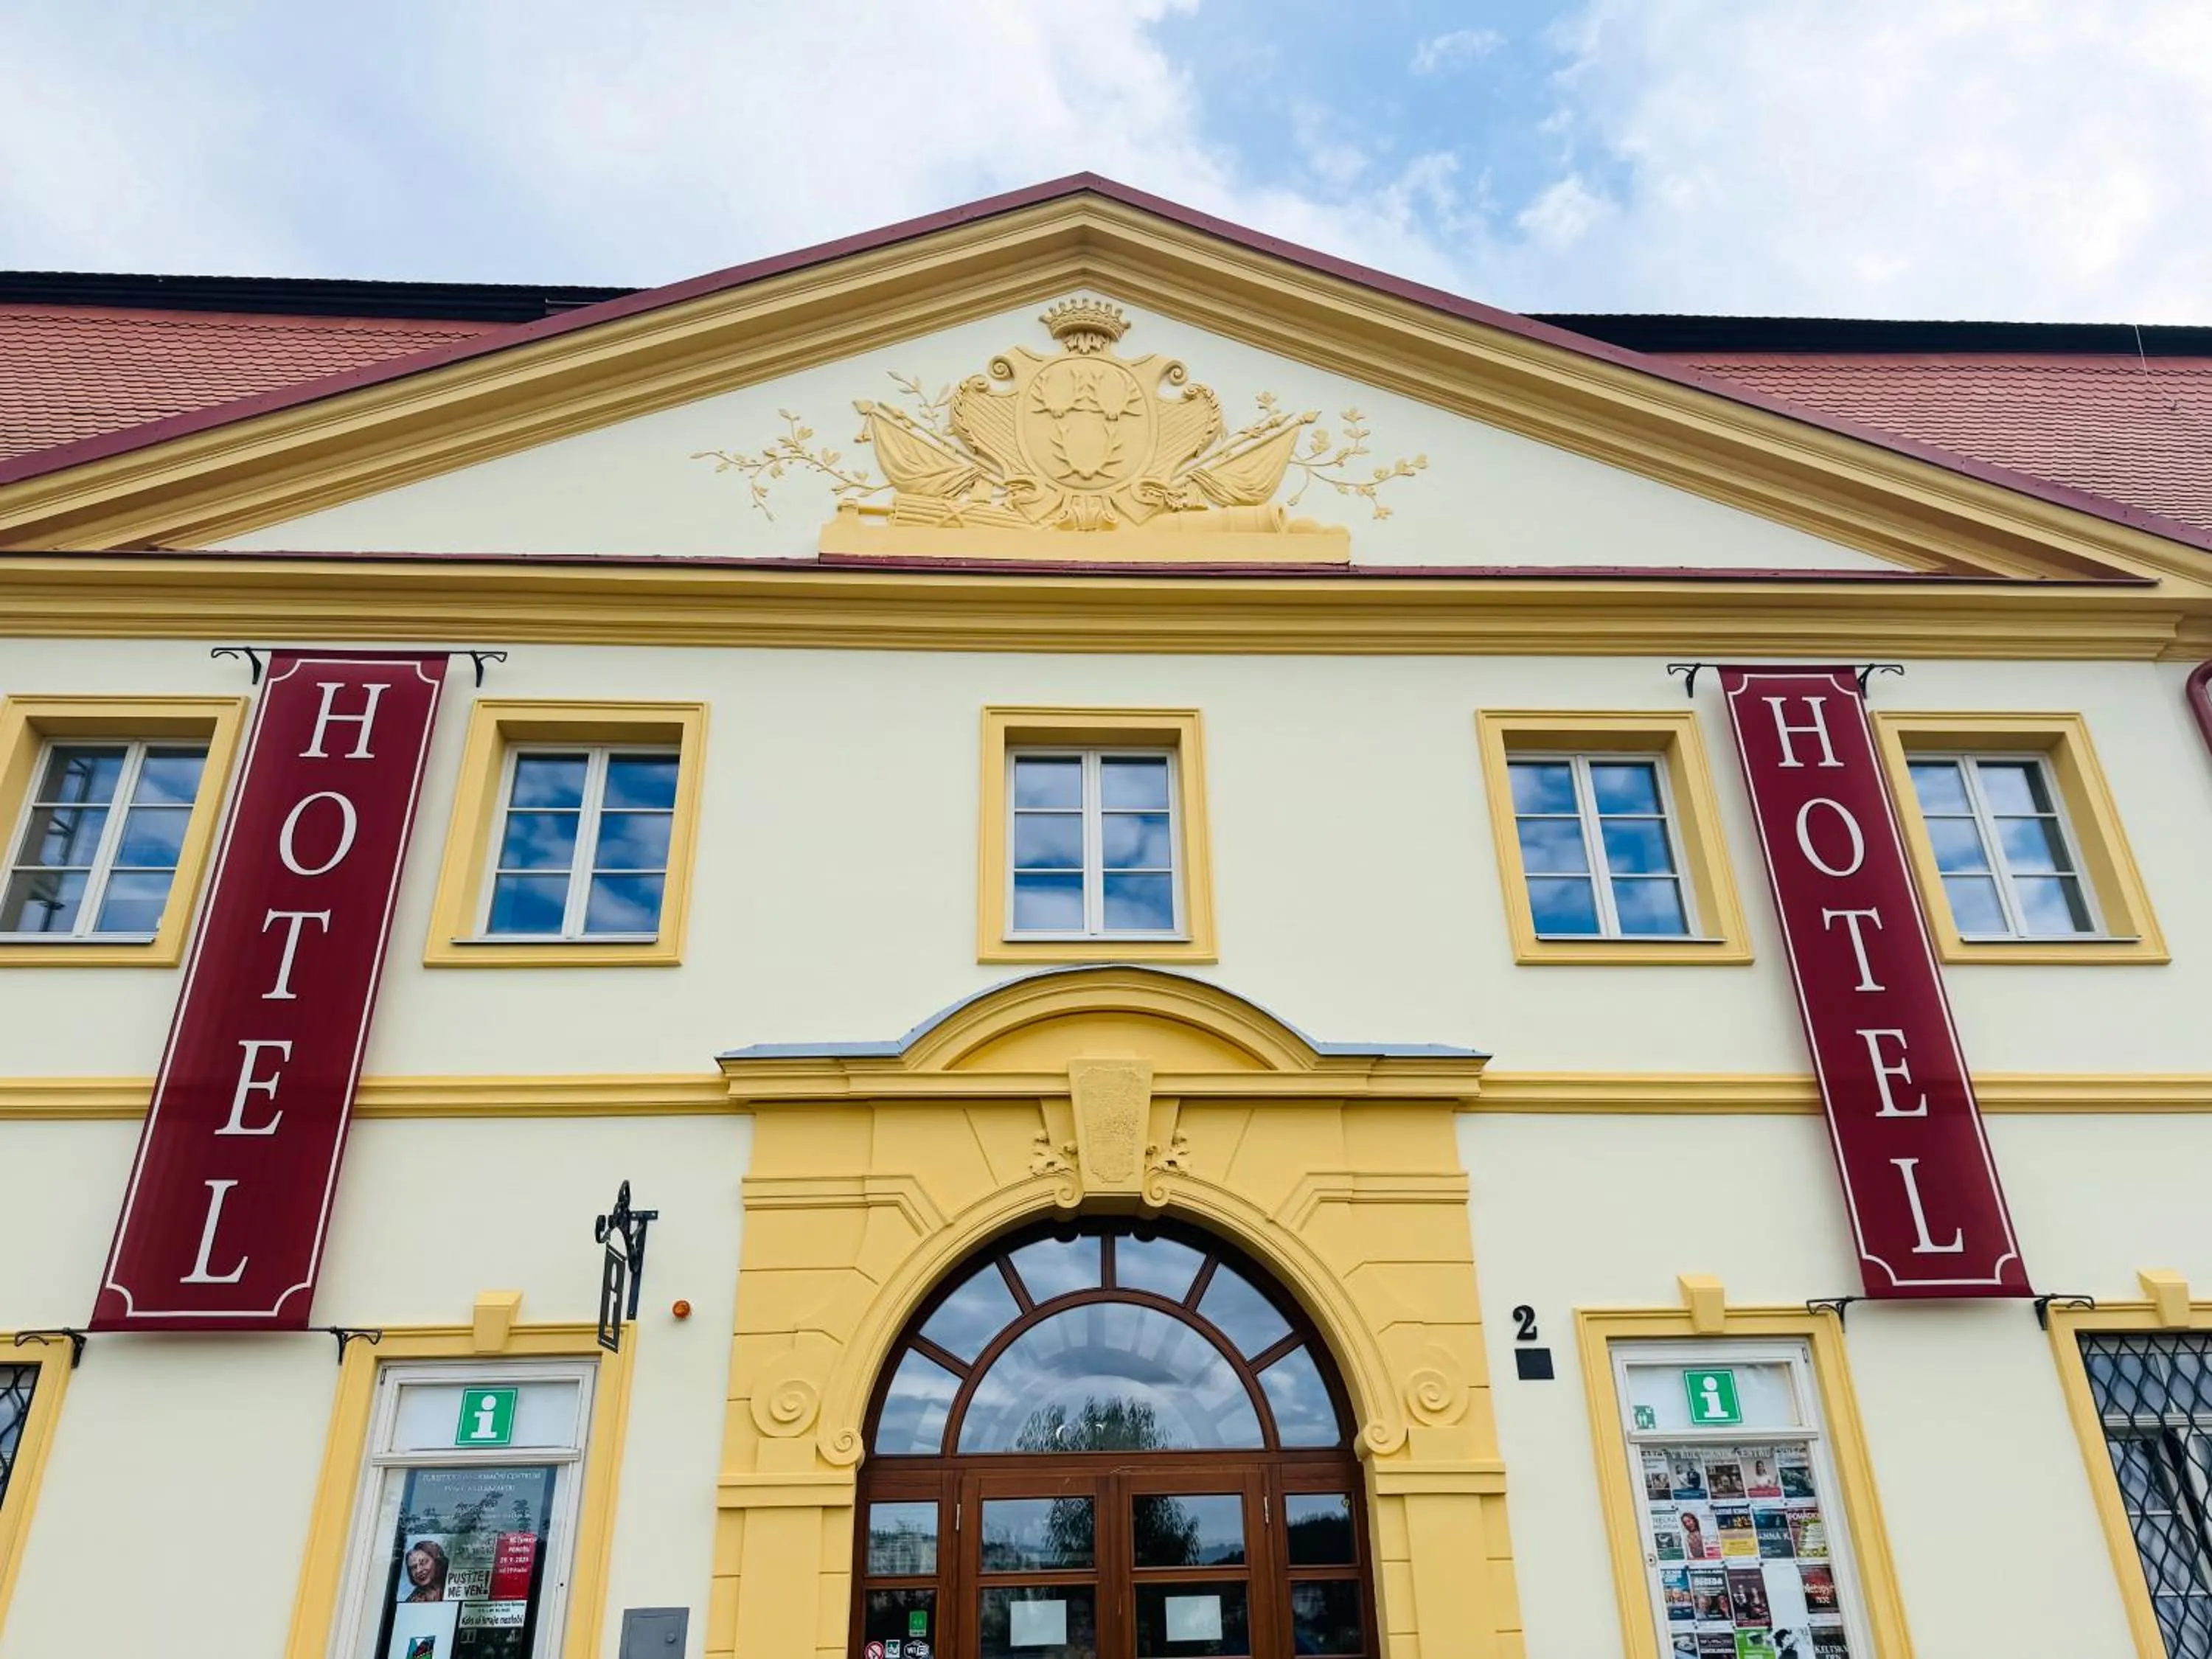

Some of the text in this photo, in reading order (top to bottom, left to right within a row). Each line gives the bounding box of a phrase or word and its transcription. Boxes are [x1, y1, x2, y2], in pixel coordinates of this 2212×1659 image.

[180, 682, 391, 1284] HOTEL
[1762, 696, 1964, 1253] HOTEL
[1512, 1304, 1537, 1340] 2
